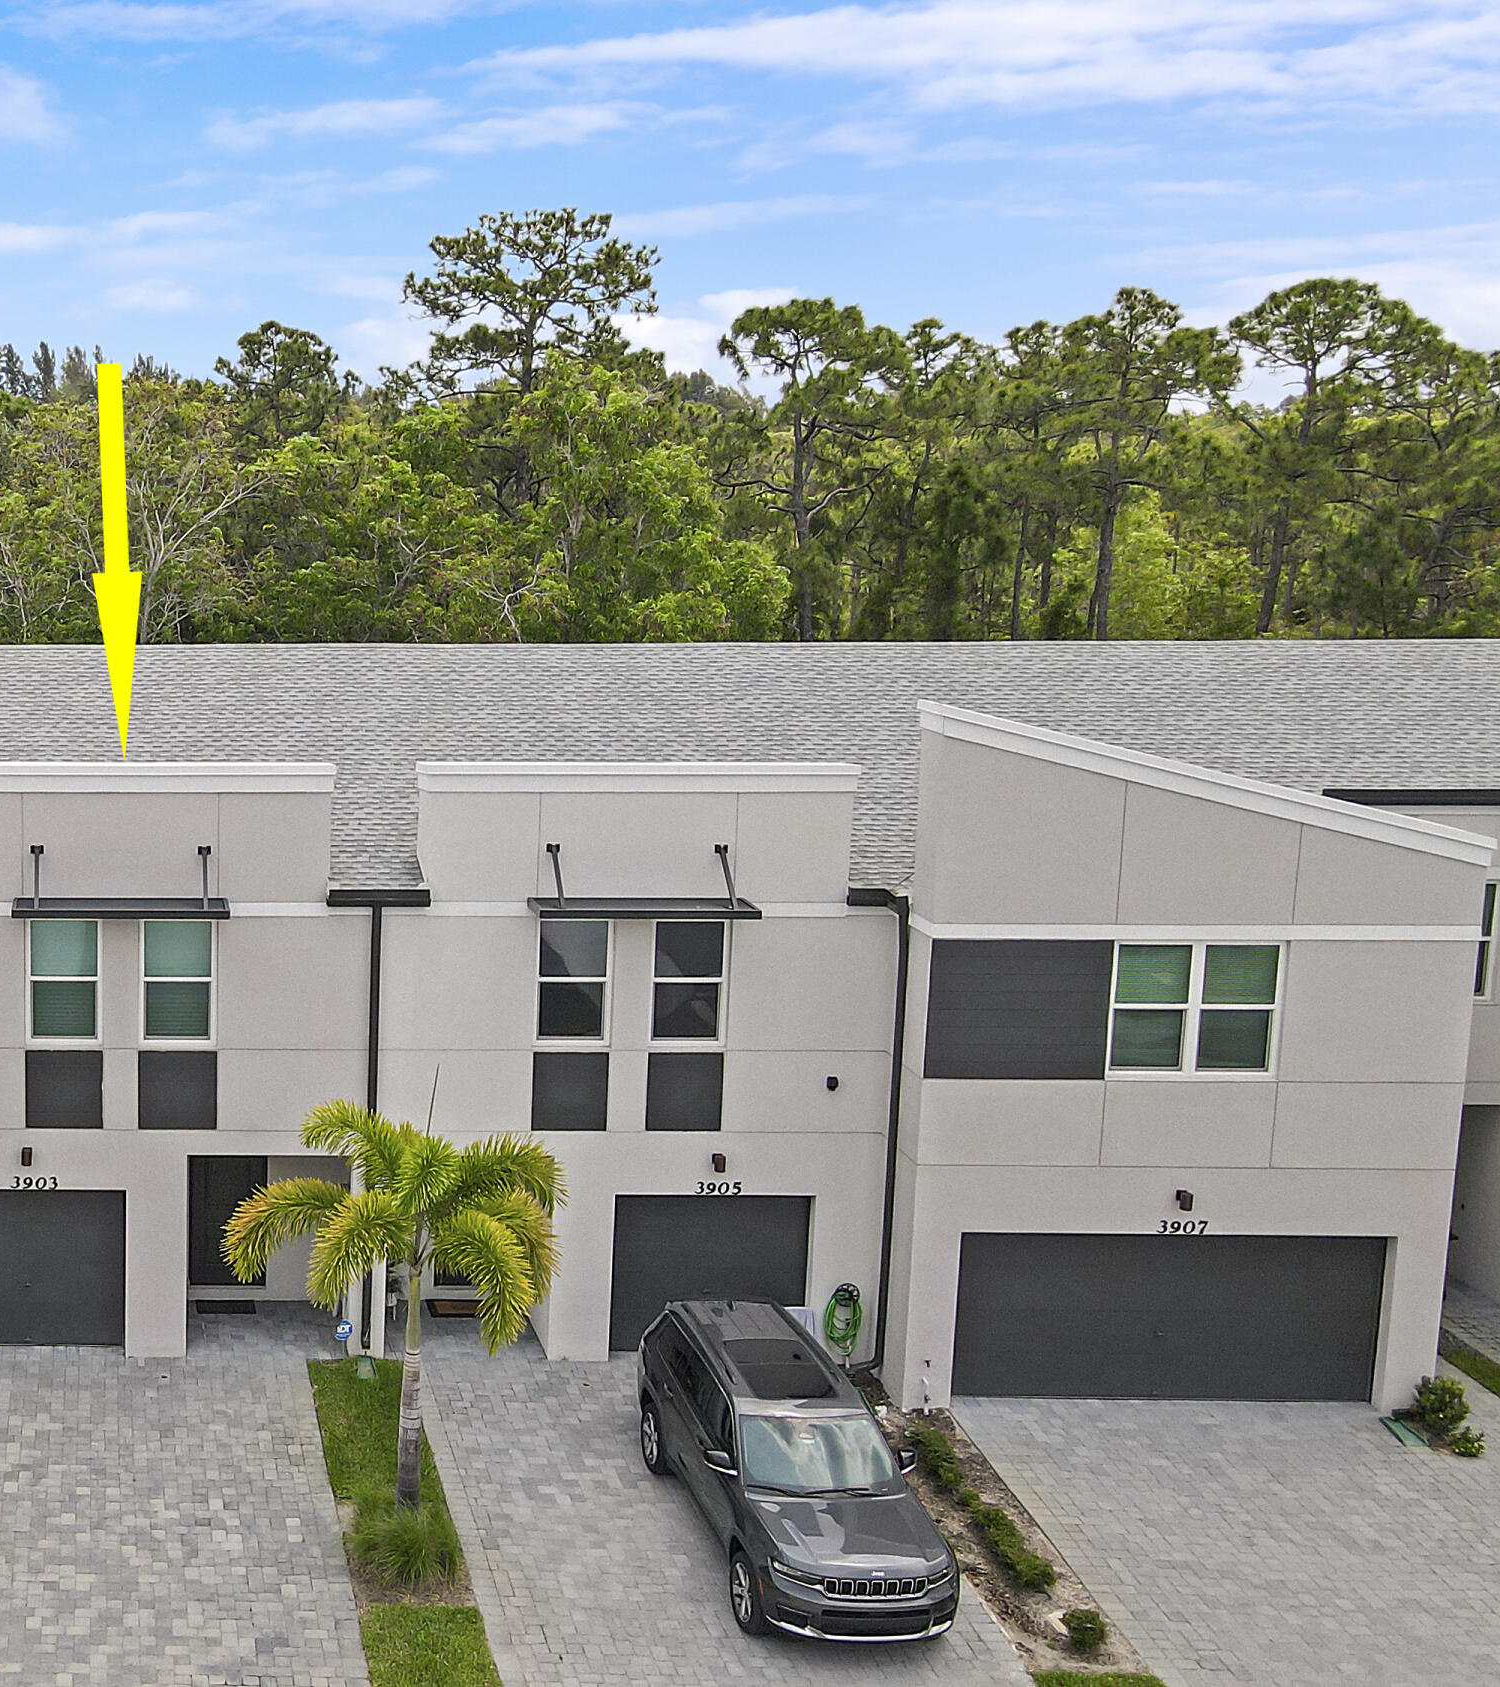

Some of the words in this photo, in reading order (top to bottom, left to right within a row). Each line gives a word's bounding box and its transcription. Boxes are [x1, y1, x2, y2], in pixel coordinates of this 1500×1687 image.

[10, 1175, 59, 1190] 3903
[694, 1181, 742, 1195] 3905
[1156, 1219, 1209, 1234] 3907
[336, 1324, 351, 1333] ADT
